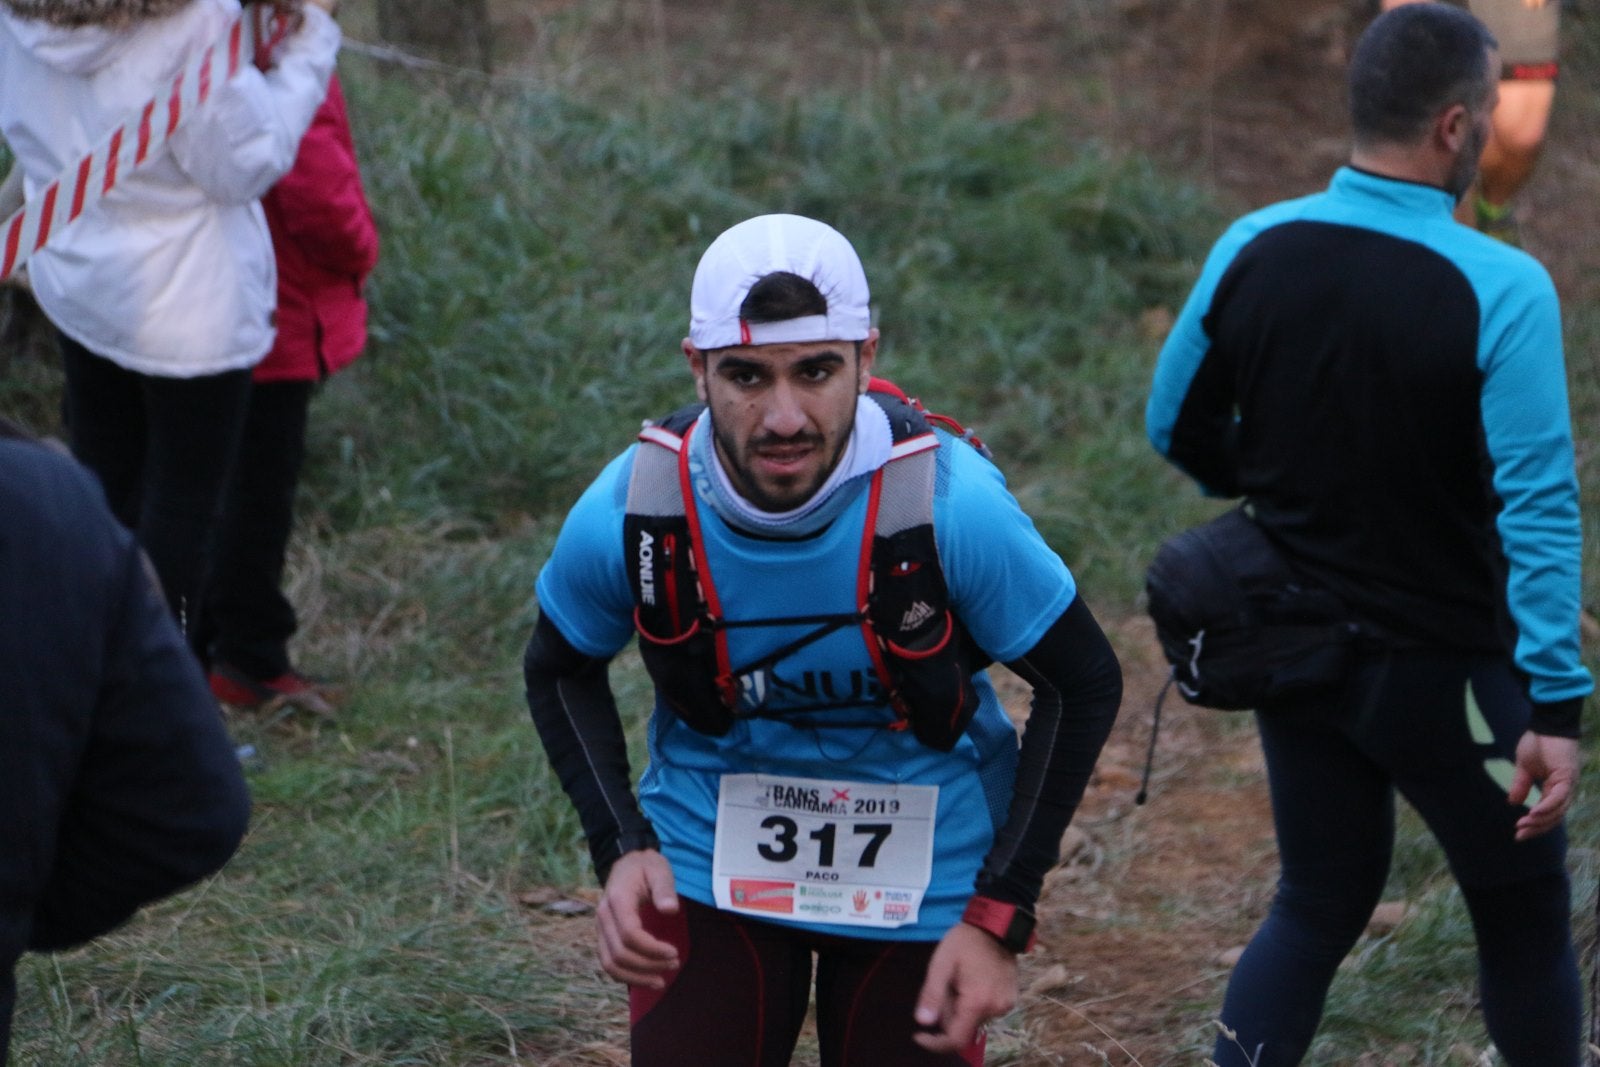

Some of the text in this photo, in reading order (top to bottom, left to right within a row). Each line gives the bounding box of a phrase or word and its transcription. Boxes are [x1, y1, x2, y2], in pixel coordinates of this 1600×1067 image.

[854, 798, 901, 815] 2019
[757, 815, 893, 868] 317
[805, 870, 840, 881] PACO
